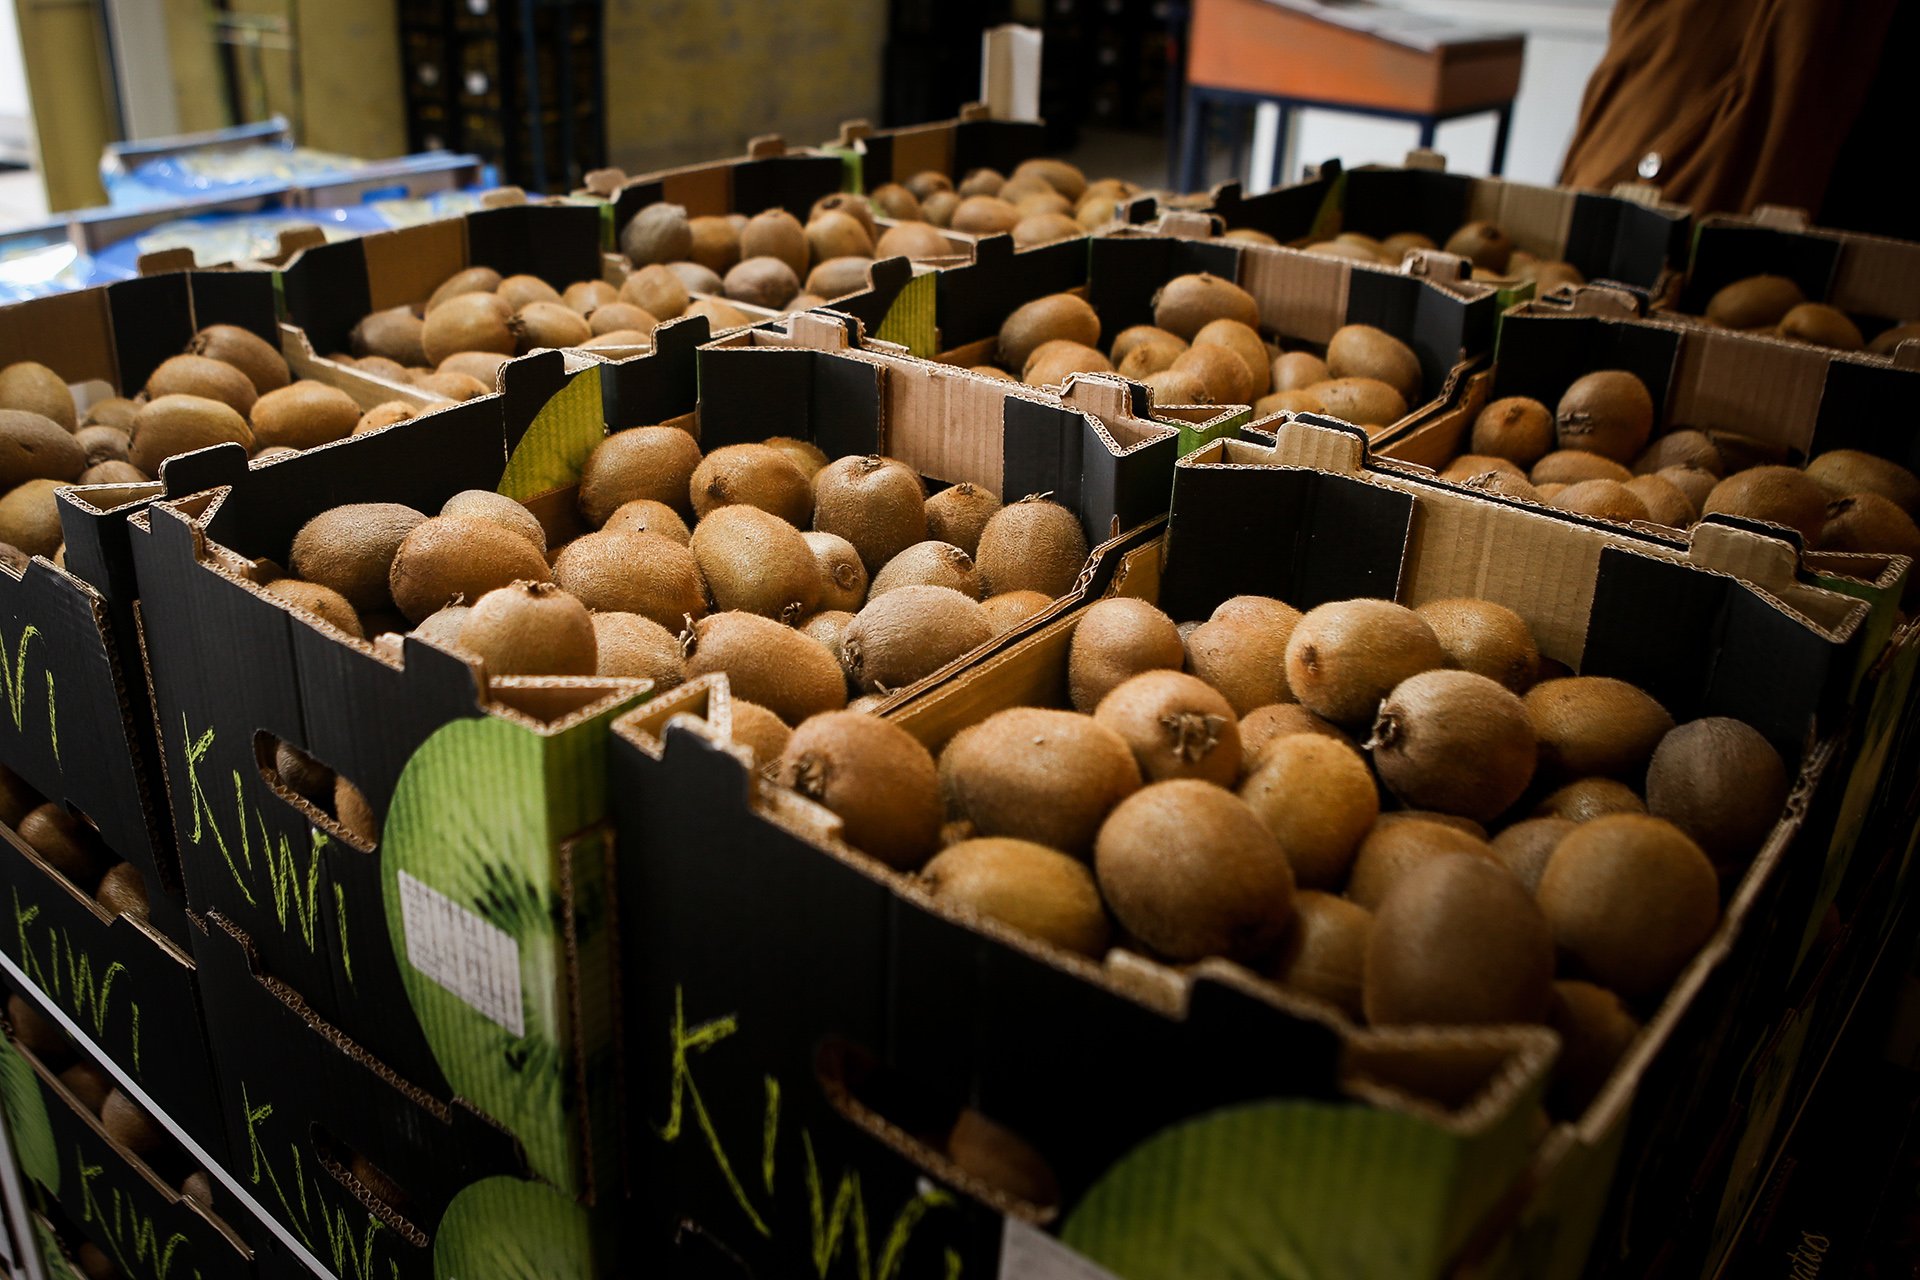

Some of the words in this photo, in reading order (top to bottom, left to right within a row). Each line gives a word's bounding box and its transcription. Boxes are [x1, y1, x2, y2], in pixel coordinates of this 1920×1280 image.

[183, 711, 357, 994] KIWI
[12, 884, 142, 1081] KIWI
[75, 1143, 203, 1280] KIW
[242, 1081, 401, 1280] KIW
[648, 983, 963, 1280] KIW
